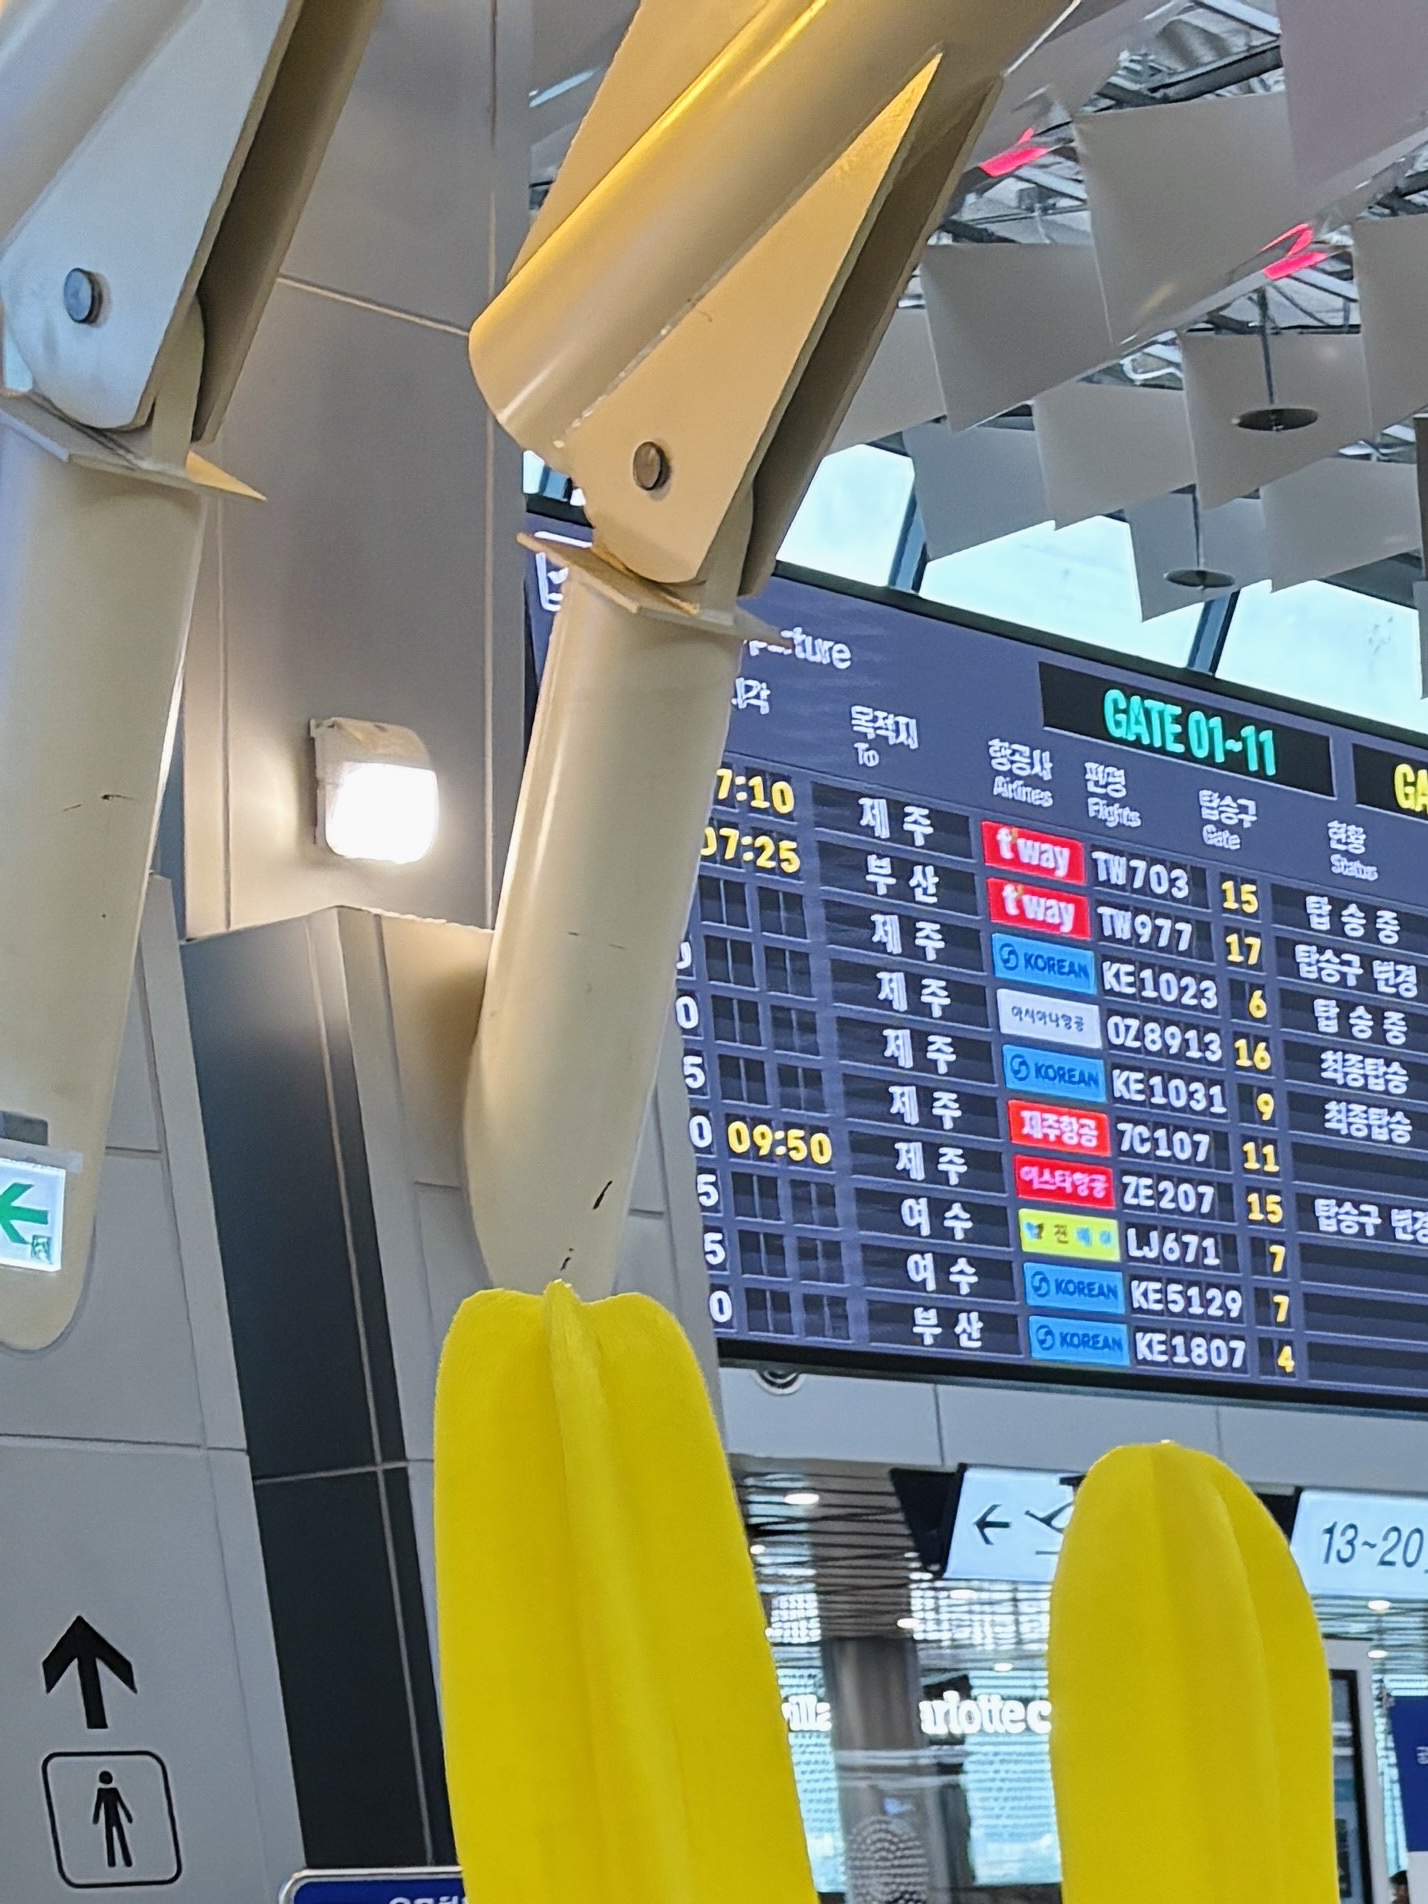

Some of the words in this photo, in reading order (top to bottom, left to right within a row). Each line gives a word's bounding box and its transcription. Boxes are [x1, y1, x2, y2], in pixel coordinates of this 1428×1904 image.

[851, 704, 919, 749] 목적지
[1104, 689, 1185, 753] GATE
[1188, 711, 1277, 776] 01~11
[853, 742, 879, 767] To
[988, 738, 1053, 781] 항공사
[993, 775, 1053, 808] Airlines
[1084, 762, 1127, 798] 편명
[1087, 797, 1142, 828] Flights
[1199, 789, 1257, 828] 탑승구
[996, 827, 1070, 877] t'way
[1202, 824, 1241, 850] Gate
[1327, 820, 1367, 855] 현황
[1091, 851, 1190, 899] TW703
[1330, 853, 1379, 882] Status
[1001, 883, 1076, 934] t'way
[1221, 880, 1258, 914] 15
[1097, 907, 1192, 951] TW977
[1023, 950, 1089, 980] KOREAN
[1225, 934, 1261, 965] 17
[1103, 961, 1218, 1009] KE1023
[1295, 945, 1364, 986] 탑승구
[1372, 959, 1418, 999] 변경
[1249, 990, 1267, 1018] 6
[1106, 1016, 1222, 1062] OZ8913
[1234, 1038, 1272, 1070] 16
[1034, 1061, 1099, 1089] KOREAN
[1112, 1069, 1227, 1114] KE1031
[1320, 1051, 1409, 1095] 최종탑승
[1256, 1092, 1274, 1121] 9
[1324, 1101, 1413, 1144] 최종탑승
[727, 1120, 833, 1165] 09:50
[1020, 1109, 1098, 1148] 제주항공
[1116, 1122, 1210, 1163] 7C107
[1242, 1141, 1280, 1173] 11
[1019, 1165, 1109, 1199] 이스타항공
[1121, 1175, 1215, 1214] ZE207
[1247, 1192, 1284, 1224] 15
[1314, 1198, 1382, 1237] 탑승구
[1126, 1227, 1221, 1266] LJ671
[1269, 1244, 1287, 1273] 7
[1054, 1278, 1119, 1301] KOREAN
[1130, 1279, 1243, 1318] KE5129
[1272, 1295, 1290, 1323] 7
[1059, 1330, 1124, 1351] KOREAN
[1135, 1331, 1246, 1369] KE1807
[1276, 1344, 1295, 1374] 4
[1321, 1520, 1424, 1569] 13~20
